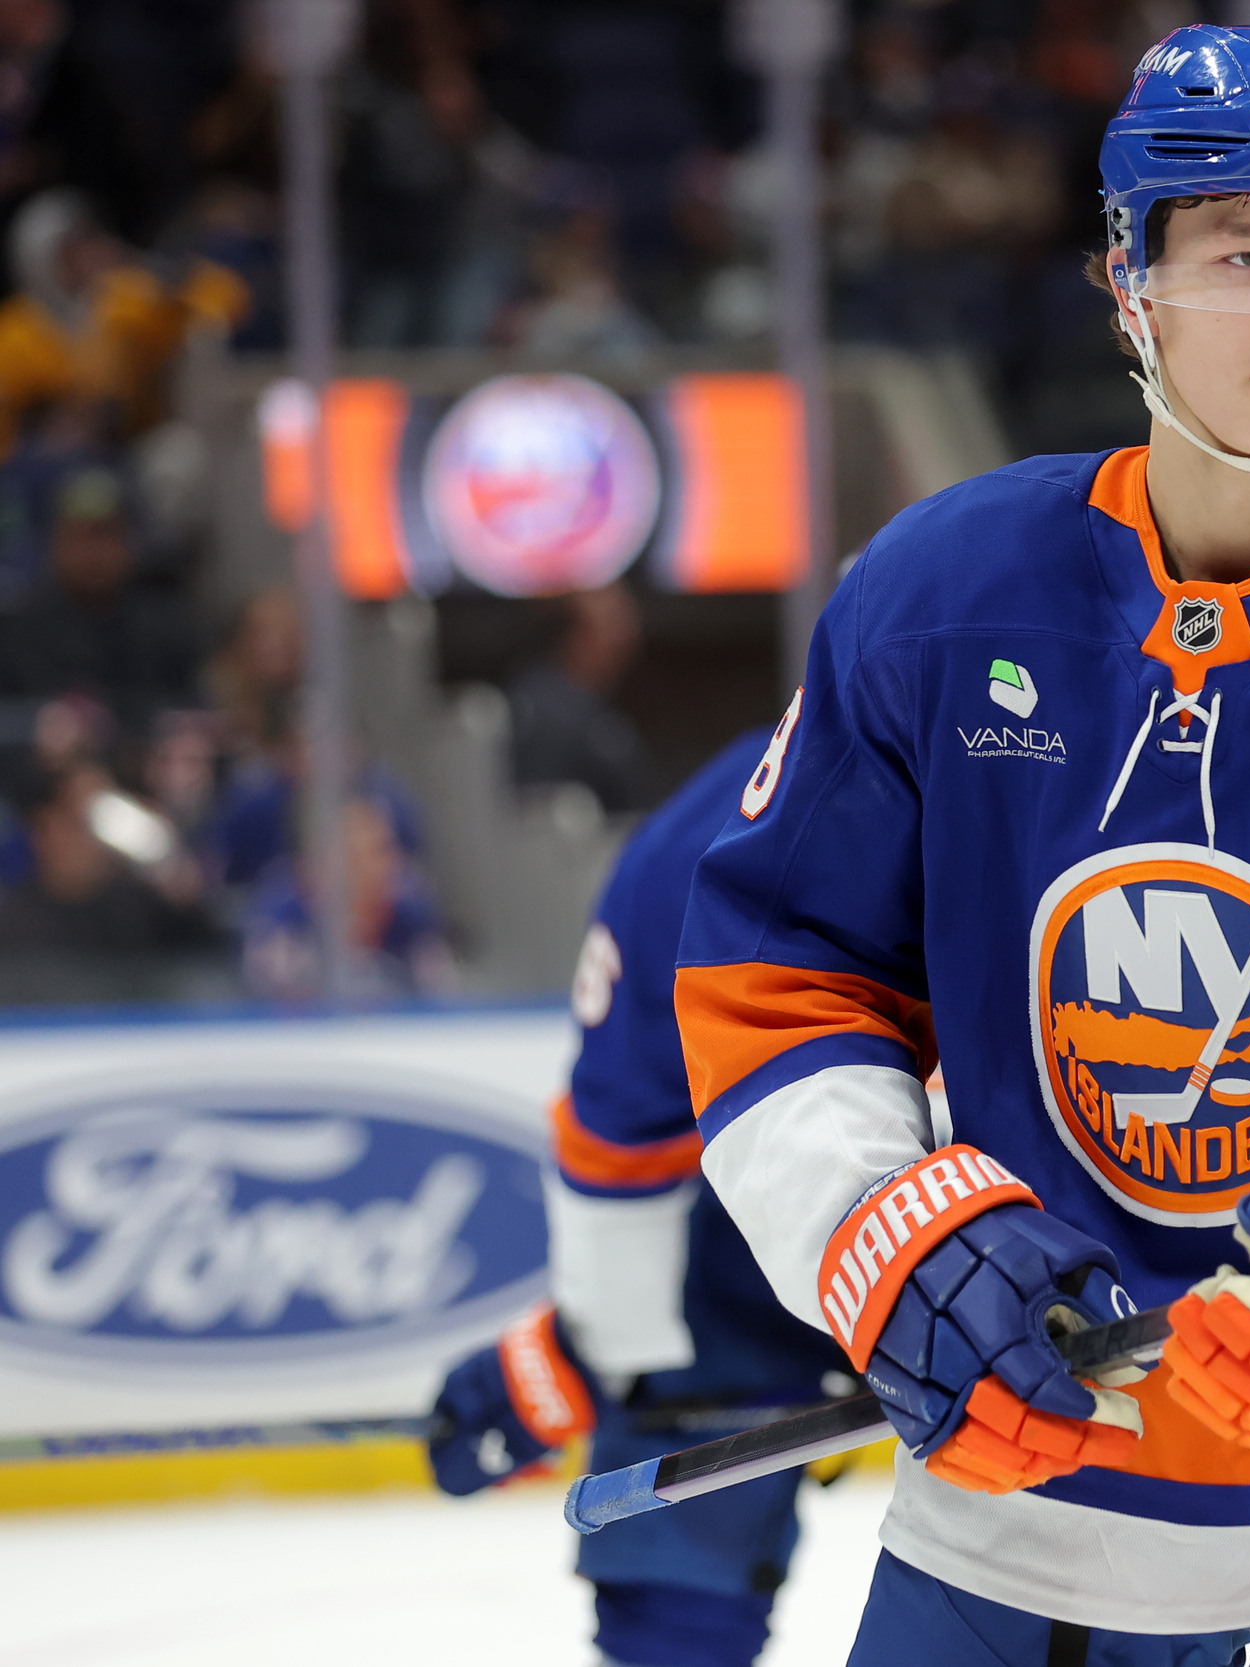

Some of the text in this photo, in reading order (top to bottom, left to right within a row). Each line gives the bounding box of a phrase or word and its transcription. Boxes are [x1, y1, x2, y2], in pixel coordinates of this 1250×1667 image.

[1183, 612, 1213, 641] NHL
[956, 726, 1067, 755] VANDA
[4, 1108, 486, 1330] Ford
[847, 1161, 916, 1219] CHAEFER
[823, 1152, 1033, 1348] WARRIO
